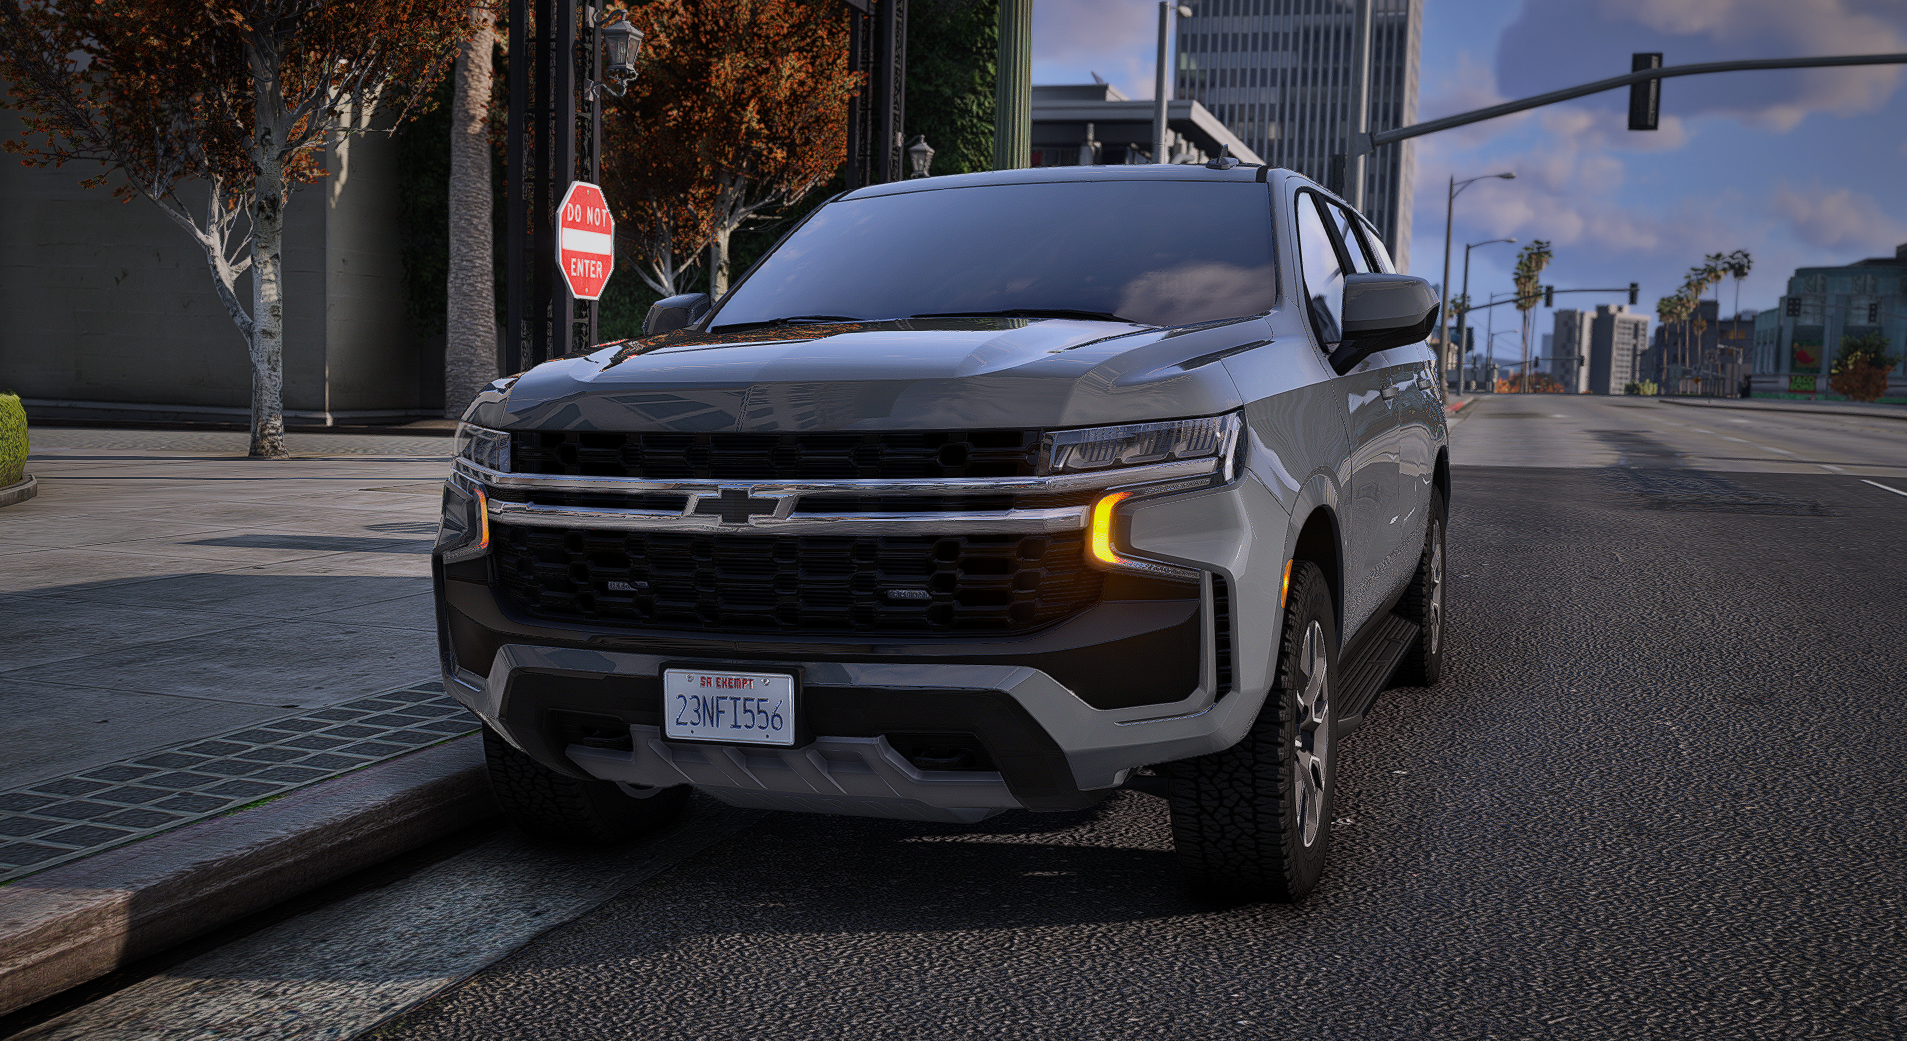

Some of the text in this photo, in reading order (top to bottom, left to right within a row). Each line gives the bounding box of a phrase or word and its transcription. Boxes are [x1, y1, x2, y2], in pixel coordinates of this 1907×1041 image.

[567, 203, 608, 227] DO NOT
[570, 258, 602, 279] ENTER
[716, 677, 754, 689] EXEMPT
[675, 694, 784, 731] 23NFI556
